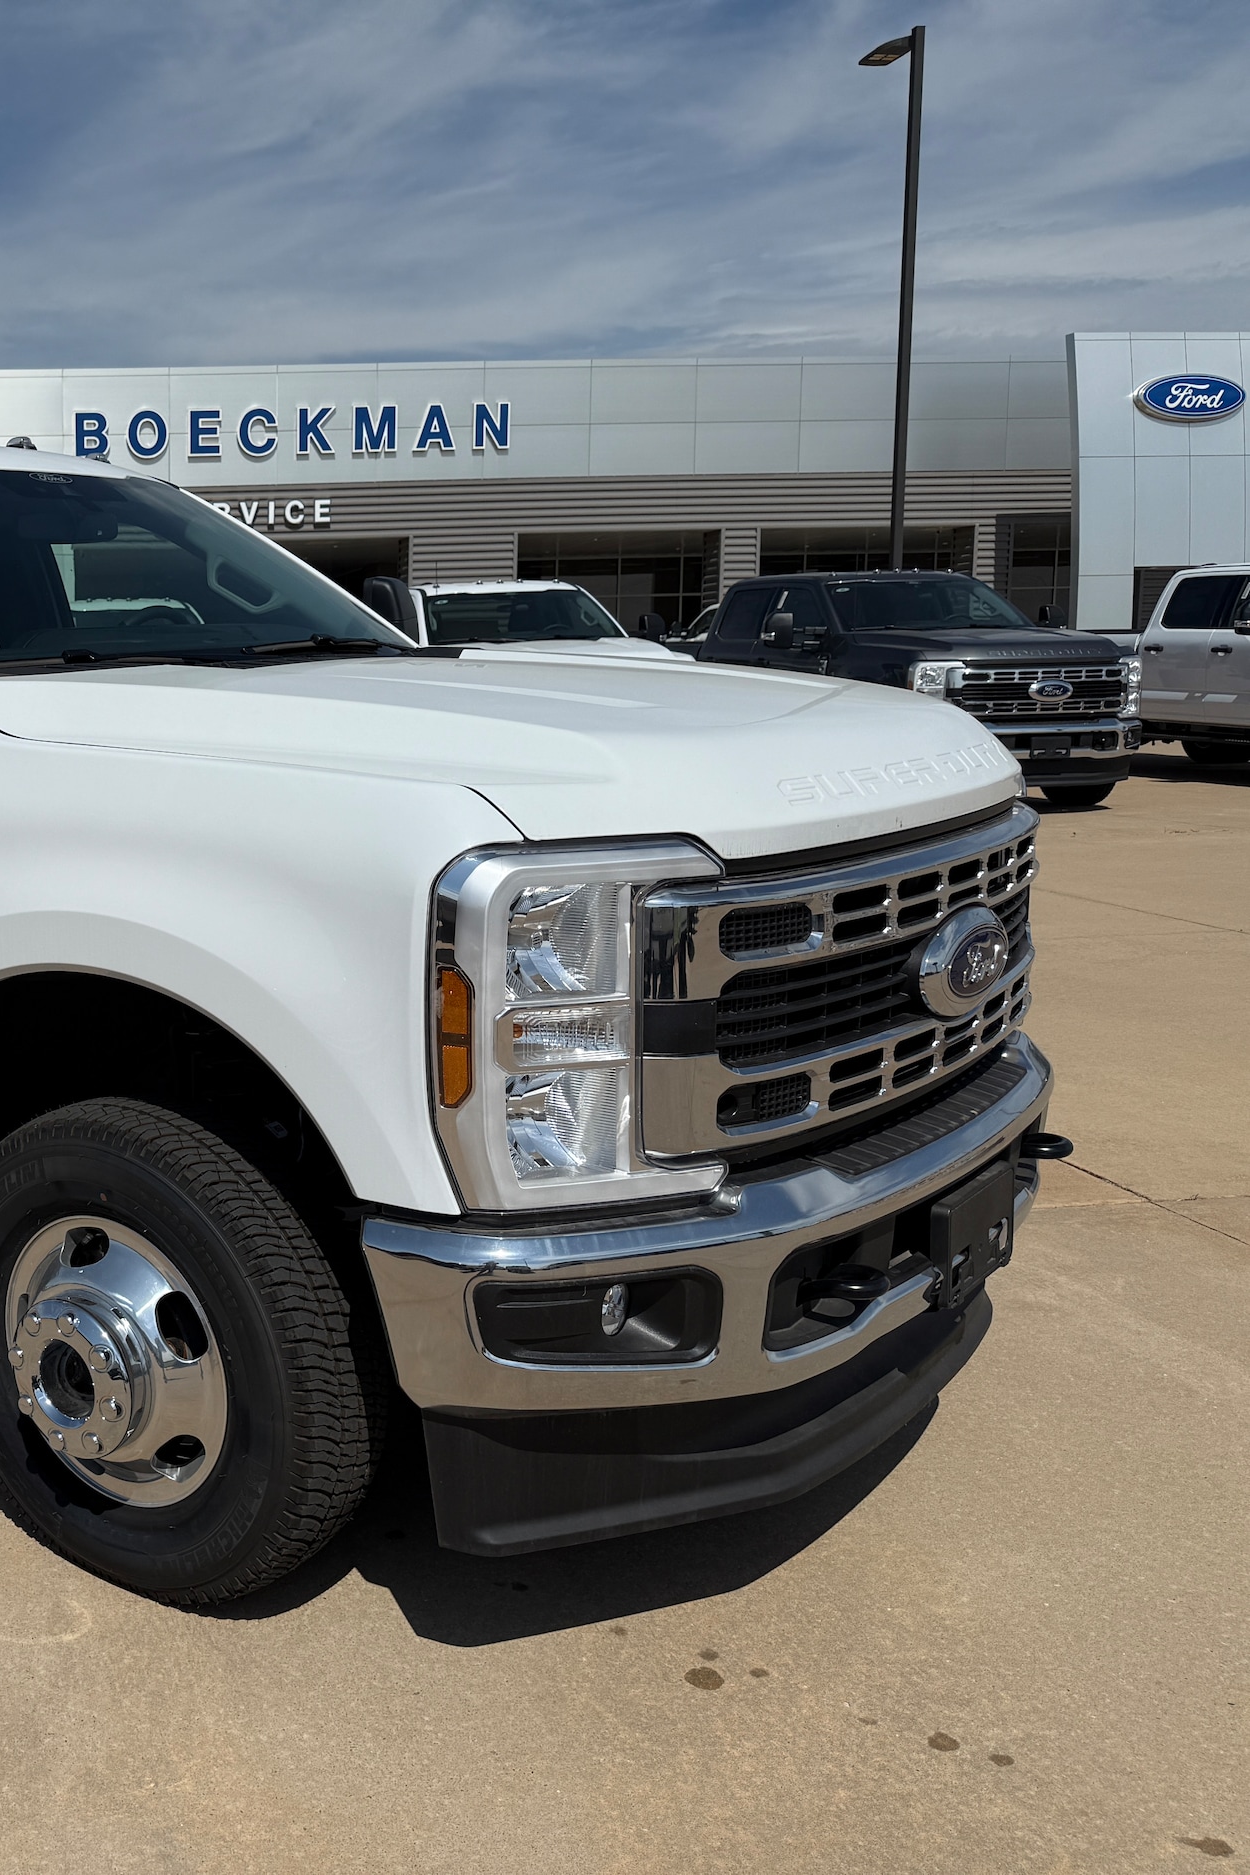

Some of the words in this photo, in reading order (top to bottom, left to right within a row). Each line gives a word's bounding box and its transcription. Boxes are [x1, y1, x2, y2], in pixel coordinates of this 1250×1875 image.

[1165, 382, 1225, 409] Ford
[73, 401, 512, 460] BOECKMAN
[213, 499, 331, 526] VICE
